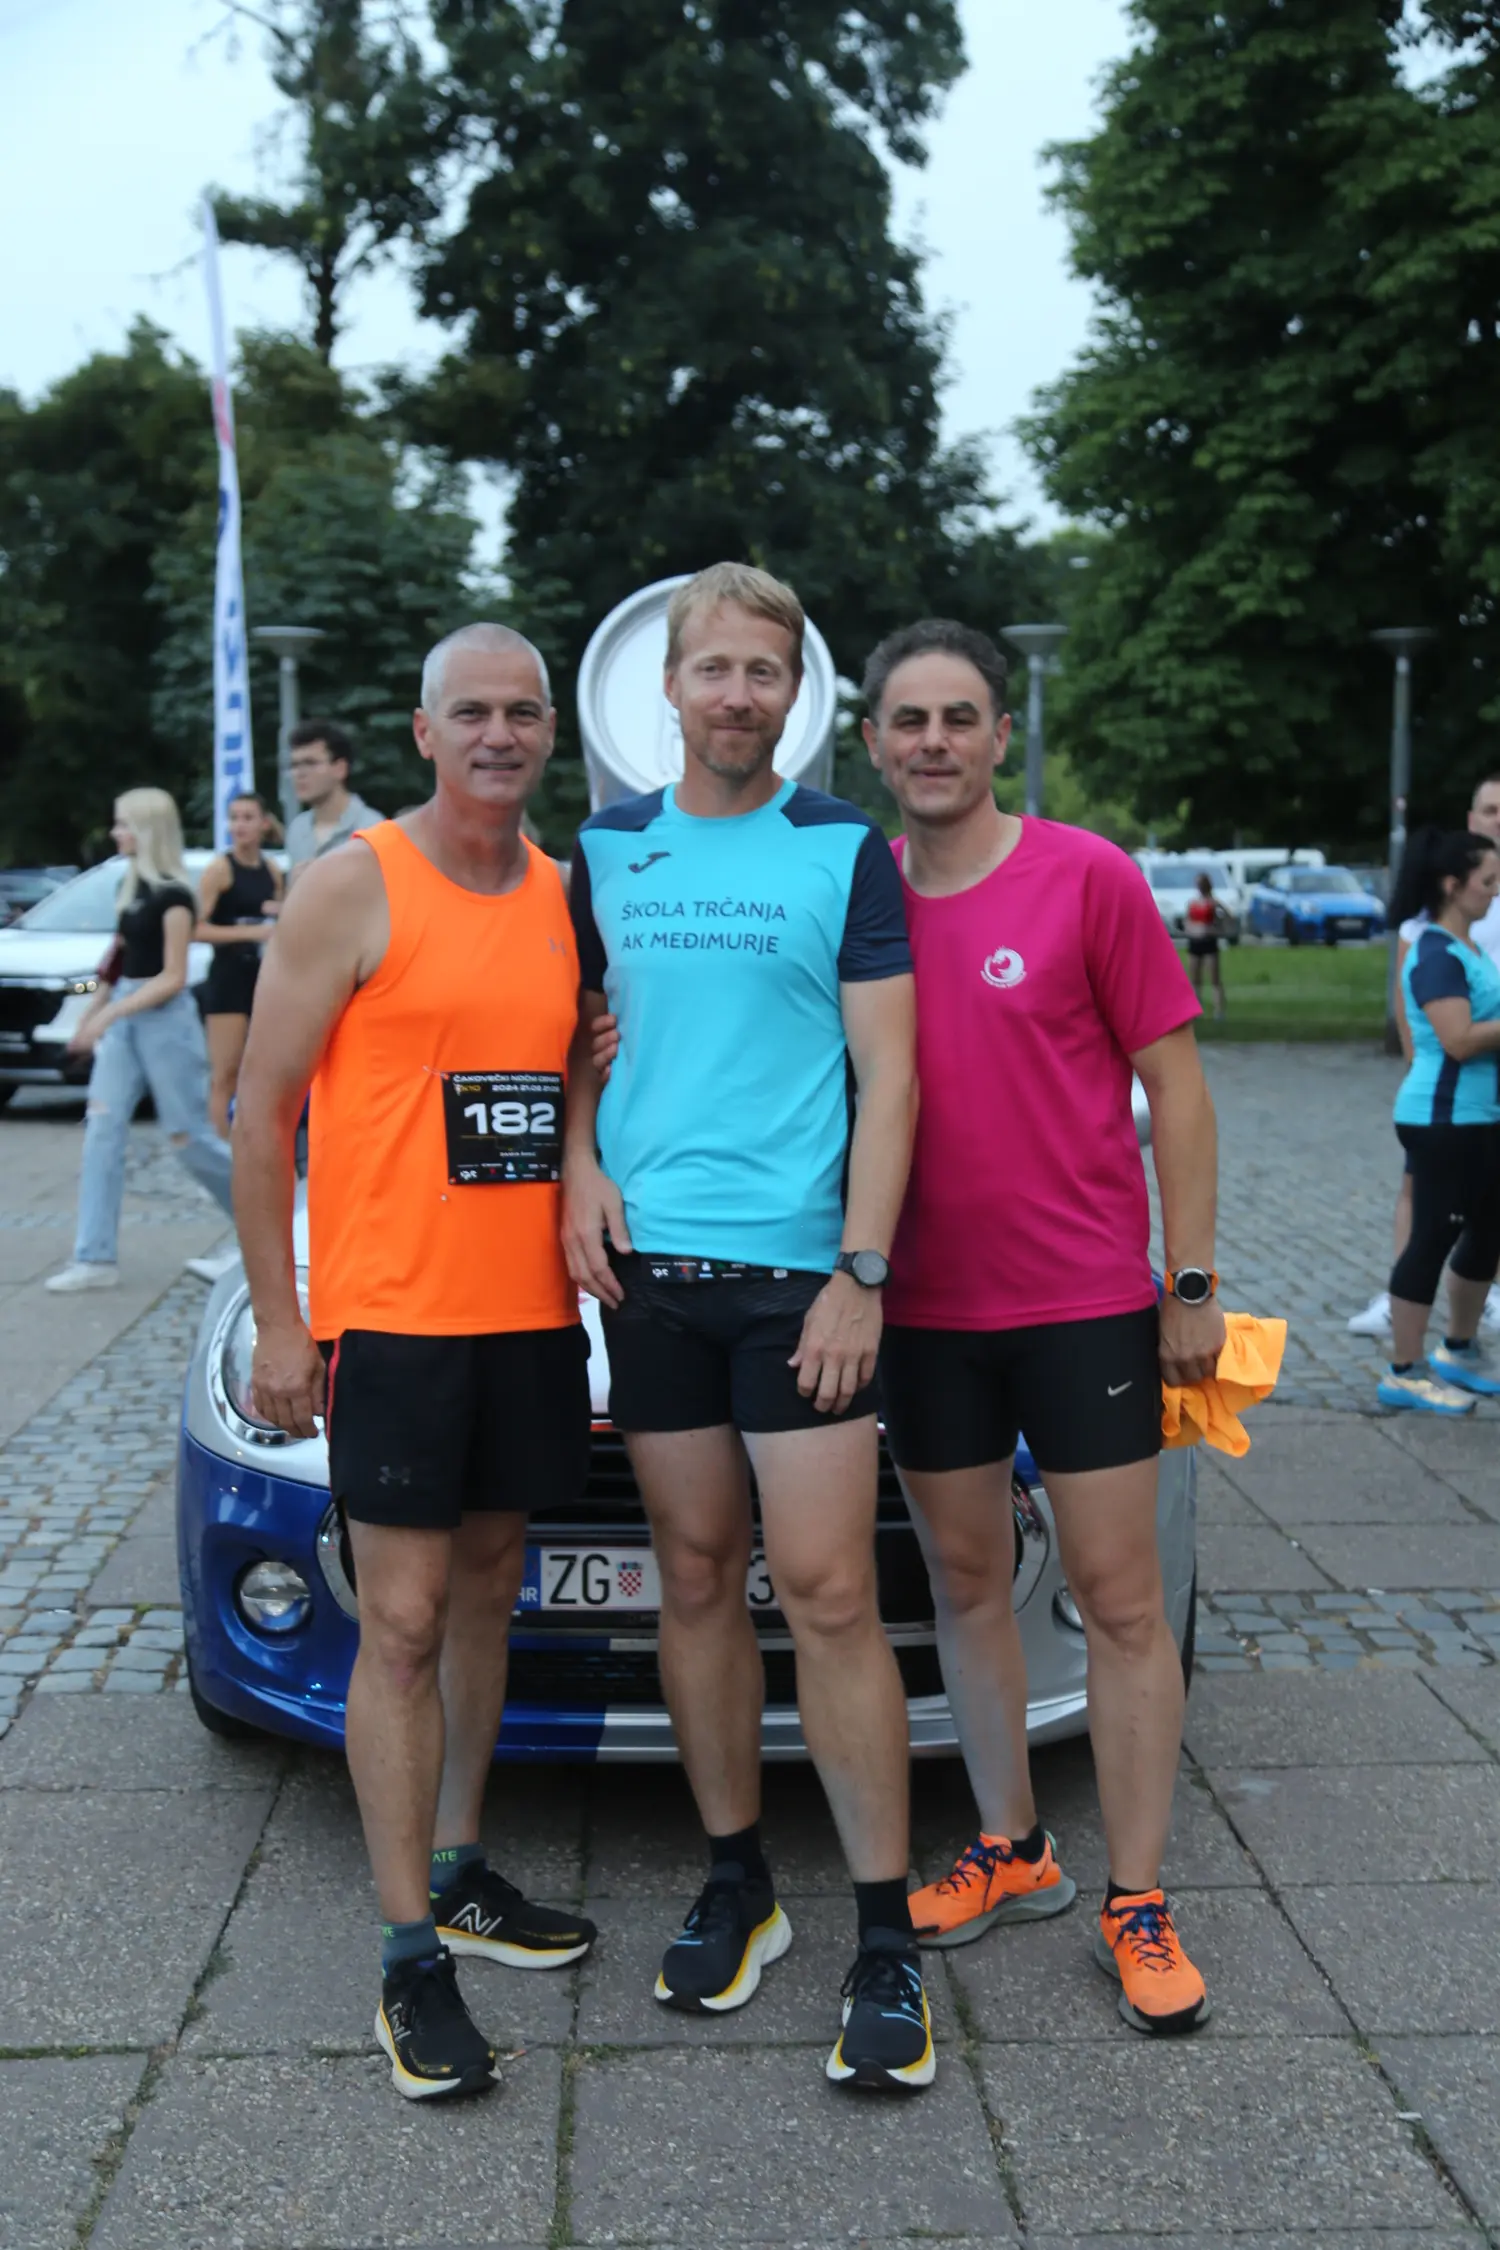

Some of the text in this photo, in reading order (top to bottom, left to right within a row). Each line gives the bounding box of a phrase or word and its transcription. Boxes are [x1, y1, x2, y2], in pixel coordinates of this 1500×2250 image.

[621, 896, 787, 923] ŠKOLA TRČANJA
[621, 932, 780, 956] AK MEĐIMURJE
[464, 1101, 556, 1135] 182
[549, 1554, 611, 1605] ZG
